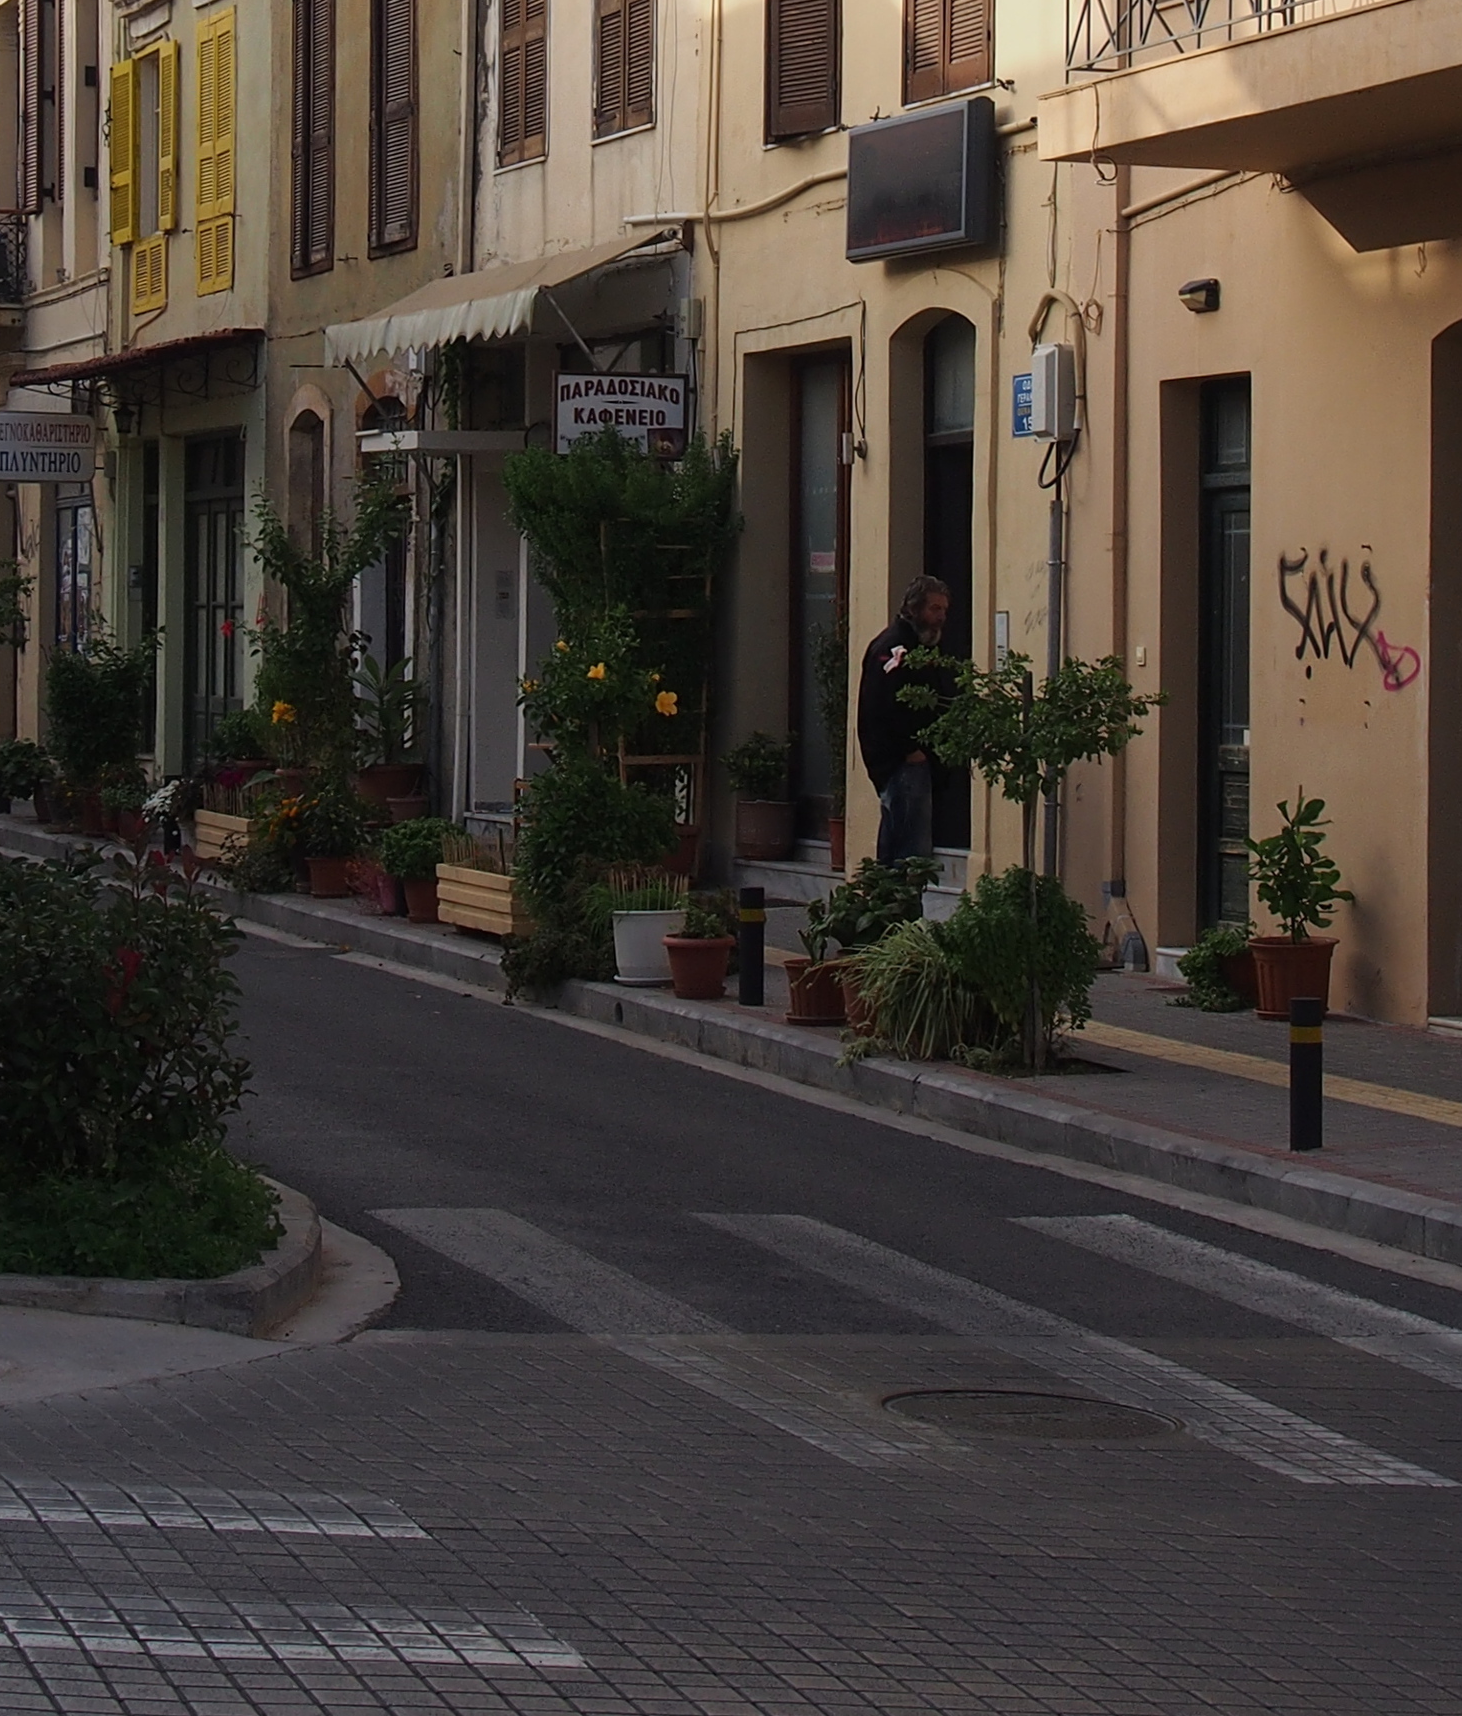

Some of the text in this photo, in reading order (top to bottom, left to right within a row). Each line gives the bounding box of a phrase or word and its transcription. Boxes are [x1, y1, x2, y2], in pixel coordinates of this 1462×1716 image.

[560, 379, 680, 405] ΠΑΡΑΔΟΣΙΑΚΟ
[573, 407, 666, 426] ΚΑΦΕΝΕΙΟ
[0, 451, 81, 473] ΠΛΥΝΤΗΡΙΟ
